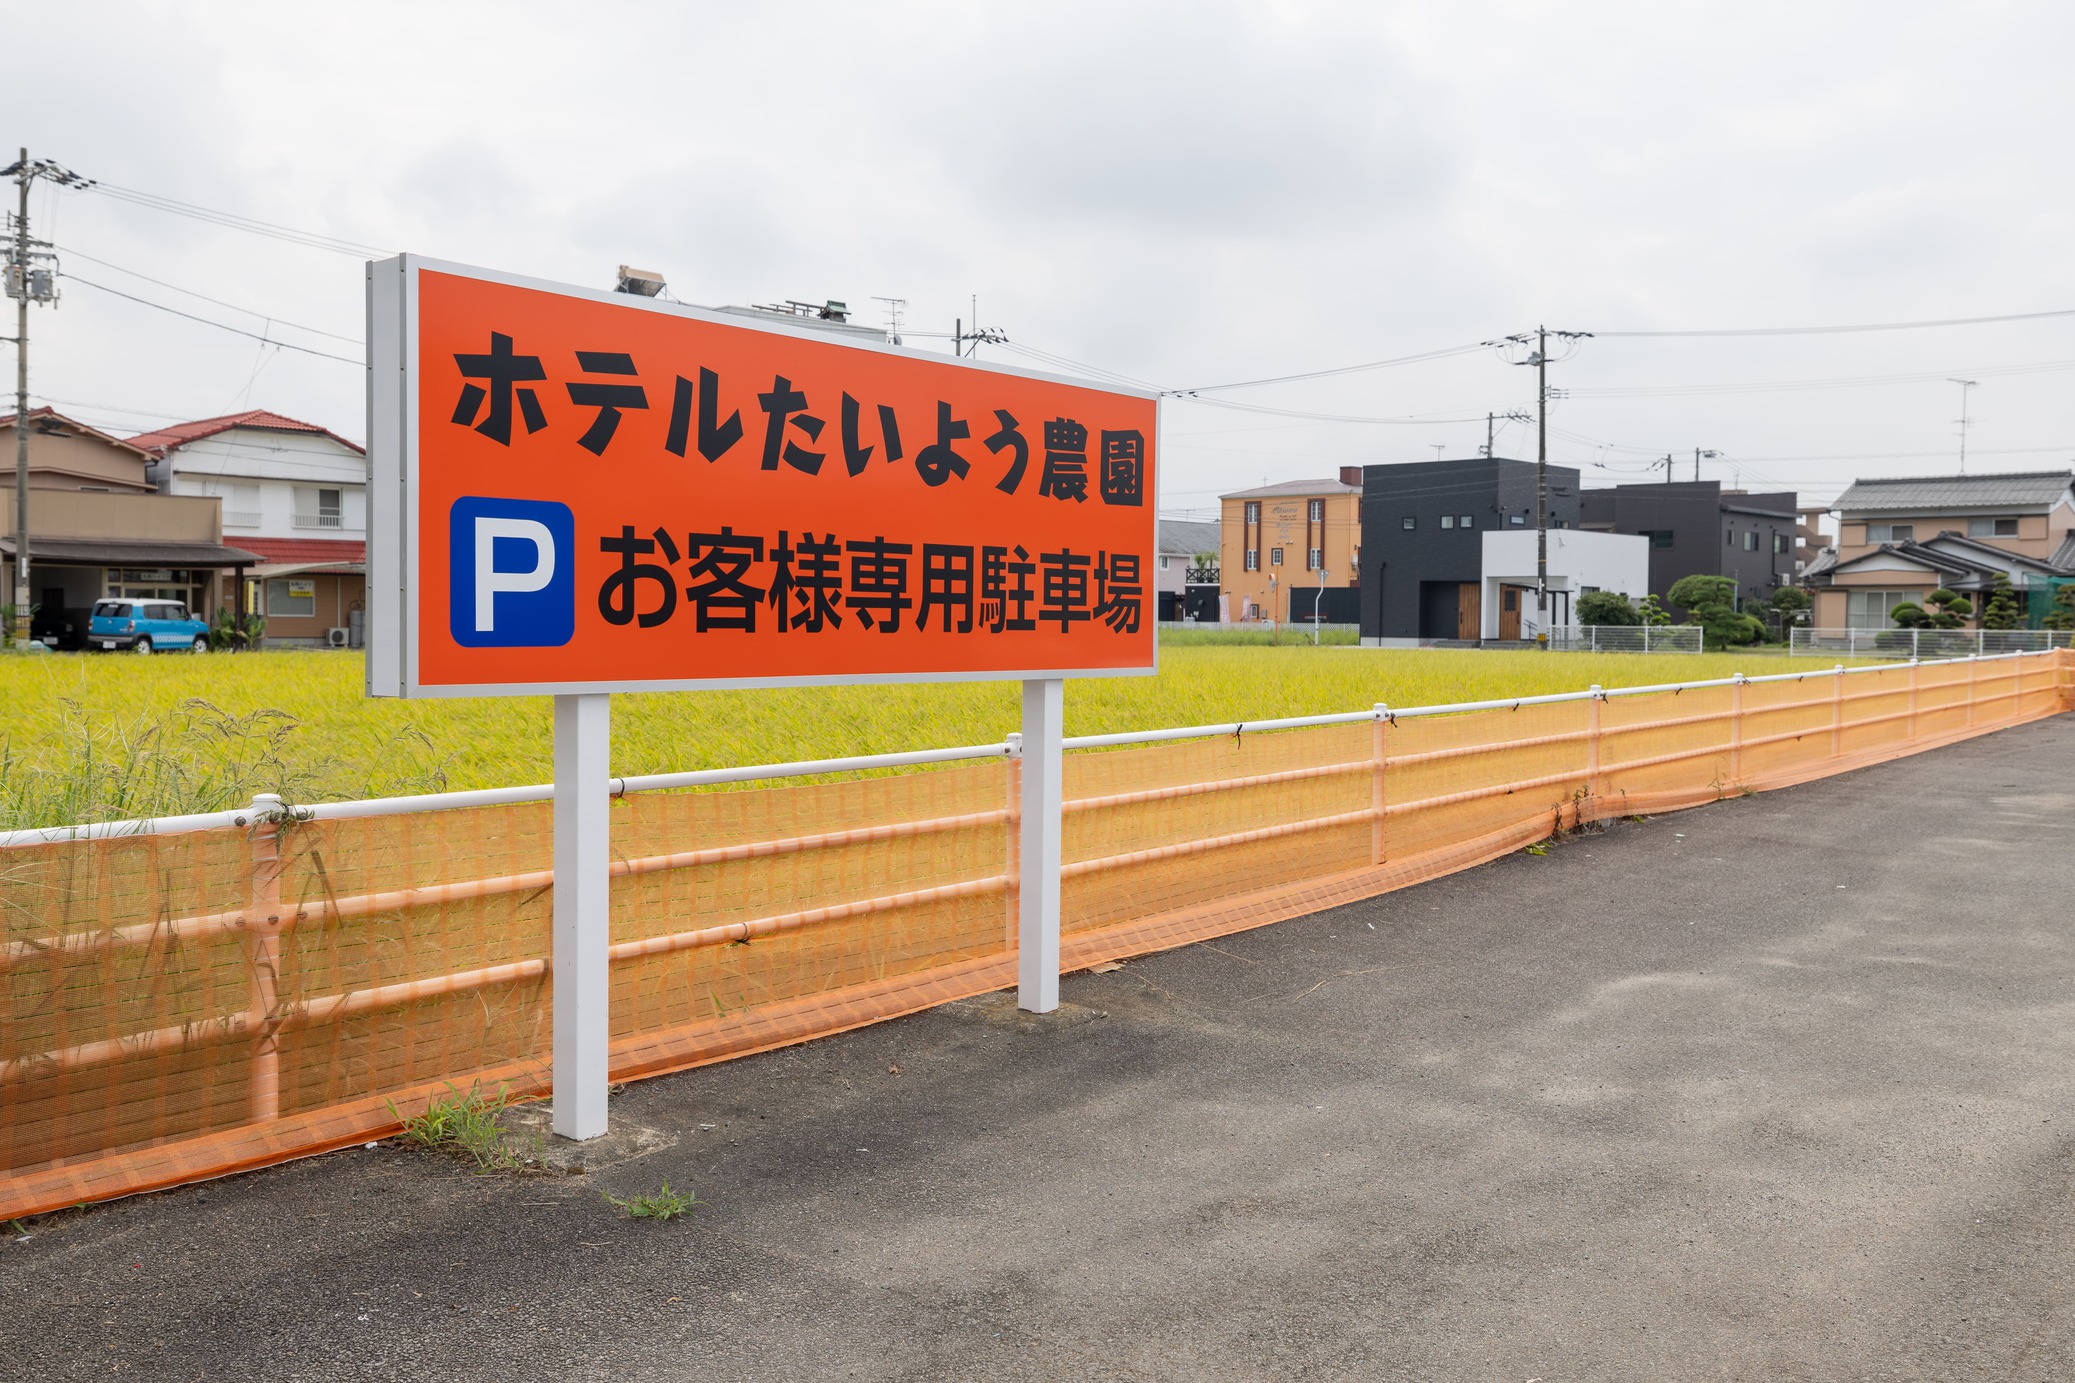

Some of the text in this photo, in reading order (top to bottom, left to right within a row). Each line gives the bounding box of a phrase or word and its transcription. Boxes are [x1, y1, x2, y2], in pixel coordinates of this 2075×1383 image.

[451, 331, 1145, 507] ホテルたいよう農園
[475, 516, 1143, 634] P お客様専用駐車場
